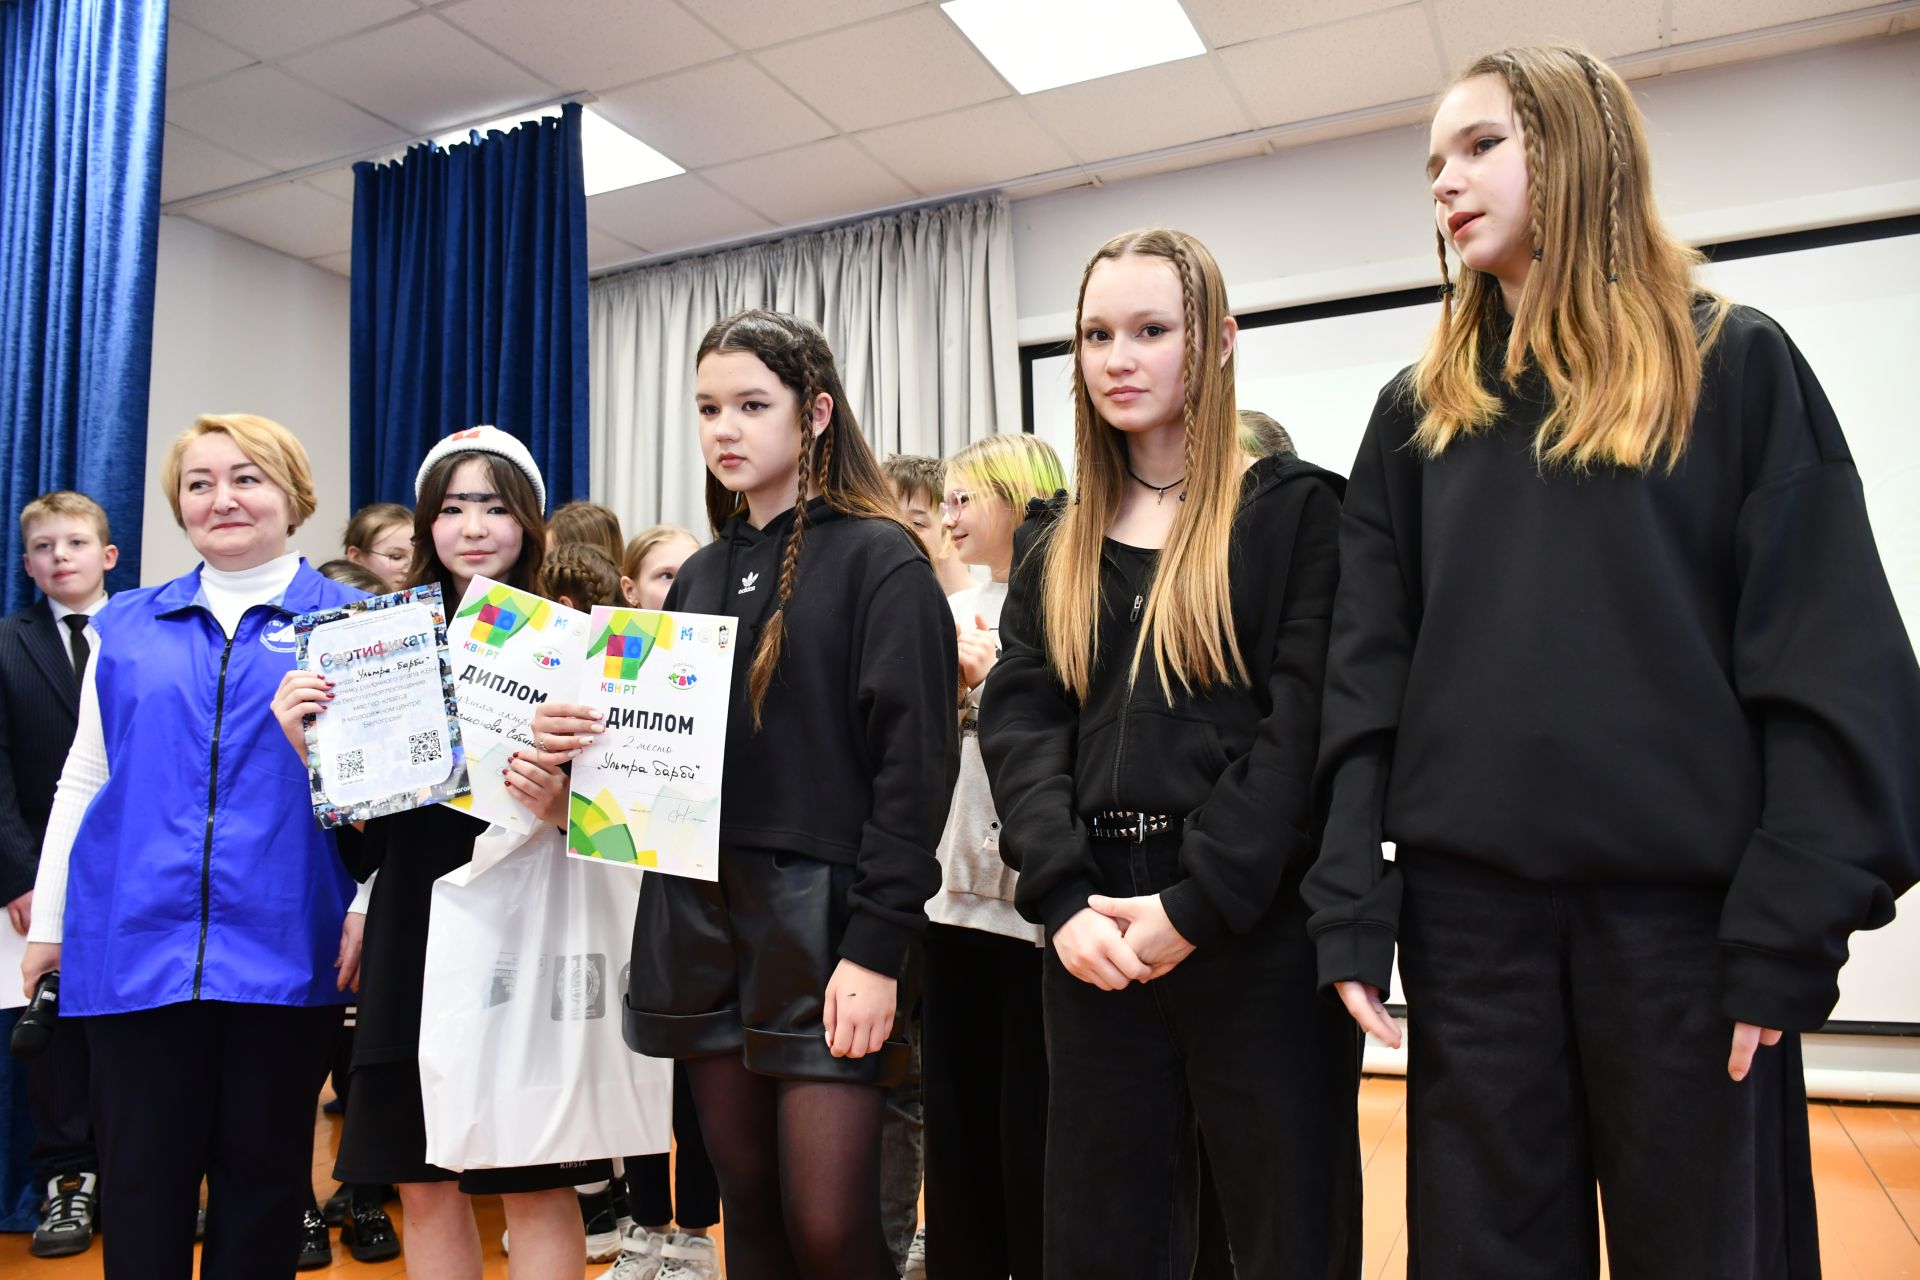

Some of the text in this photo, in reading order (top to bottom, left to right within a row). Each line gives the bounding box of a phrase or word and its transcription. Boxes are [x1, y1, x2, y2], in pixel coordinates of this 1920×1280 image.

[320, 632, 428, 667] Сертификат
[464, 641, 500, 660] КВН РТ
[459, 664, 548, 704] ДИПЛОМ
[600, 682, 637, 695] КВН РТ
[605, 707, 694, 735] ДИПЛОМ
[507, 728, 537, 748] Сабин
[622, 735, 635, 748] 2
[560, 1161, 588, 1169] KIPSTA
